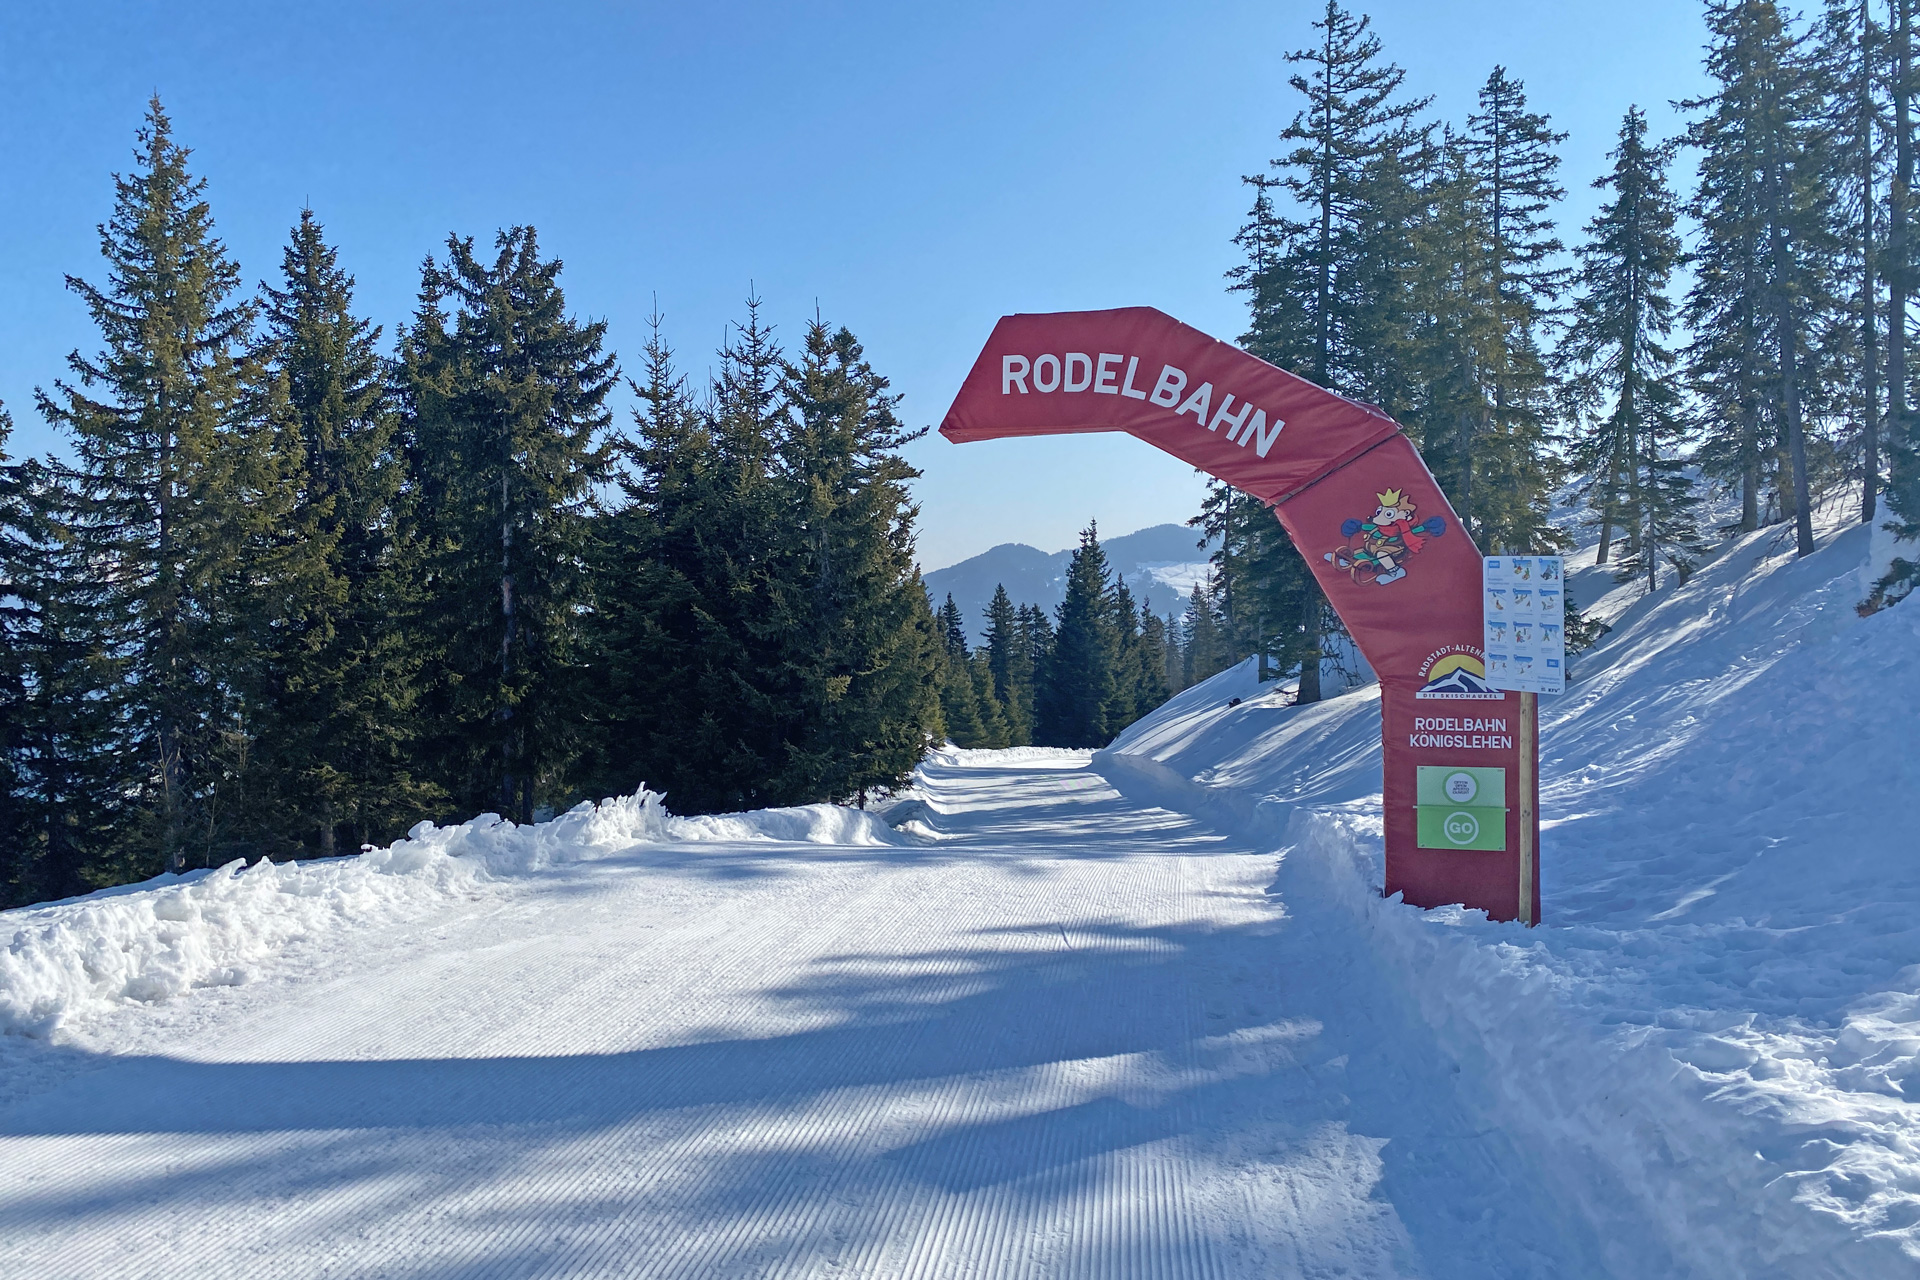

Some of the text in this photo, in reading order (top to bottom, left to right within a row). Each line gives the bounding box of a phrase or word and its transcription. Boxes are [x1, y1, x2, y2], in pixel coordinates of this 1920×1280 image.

[1002, 352, 1286, 459] RODELBAHN
[1418, 644, 1485, 677] RADSTADT-ALTENM
[1415, 718, 1507, 732] RODELBAHN
[1410, 732, 1512, 749] KÖNIGSLEHEN
[1449, 822, 1474, 834] GO
